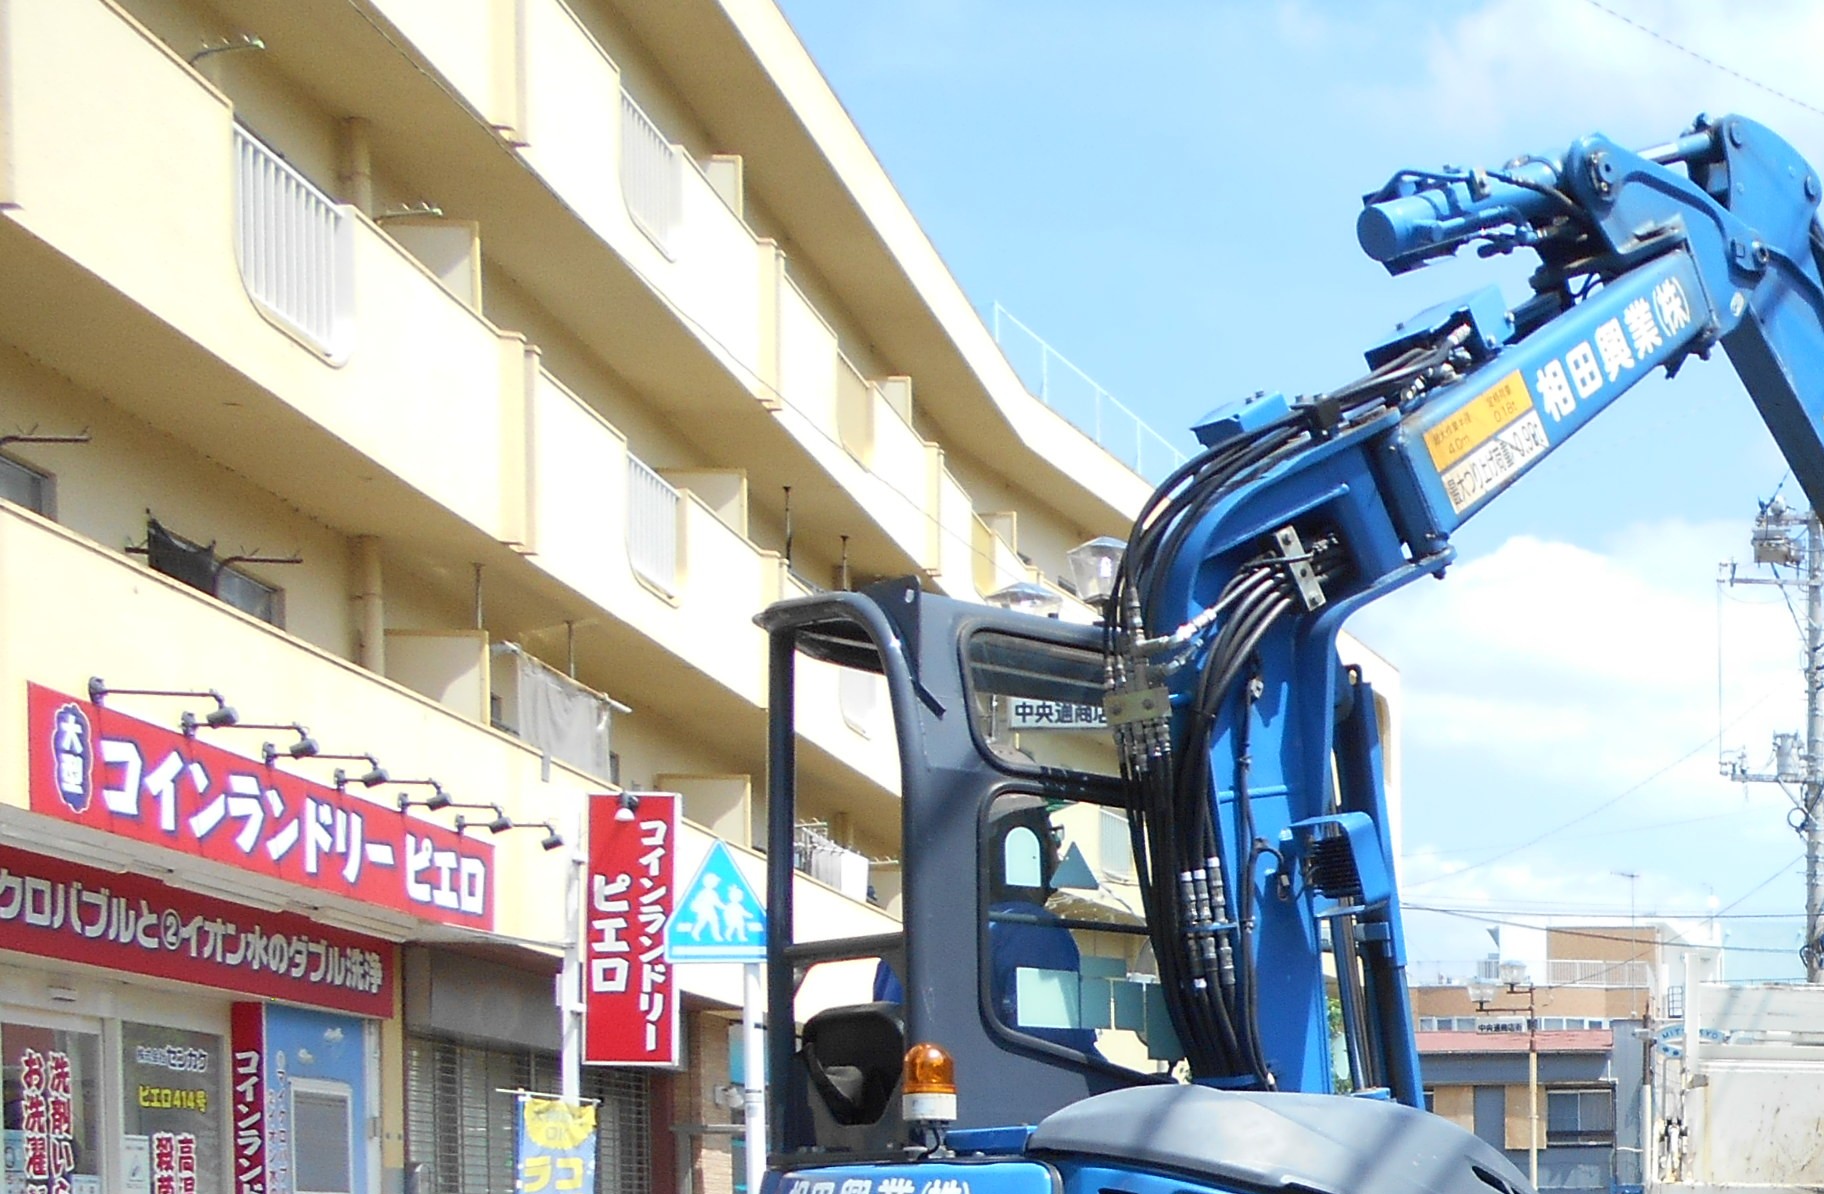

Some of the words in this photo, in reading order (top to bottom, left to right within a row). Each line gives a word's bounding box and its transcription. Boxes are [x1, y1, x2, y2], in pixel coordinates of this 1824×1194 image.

[1536, 276, 1691, 422] 相田興業(株)
[60, 716, 85, 795] 大型
[101, 738, 396, 885] コインランドリー
[405, 831, 487, 915] ピエロ
[591, 873, 632, 992] ピエロ
[638, 819, 668, 1052] コインランドリー
[21, 1048, 49, 1179] お洗濯
[138, 1085, 208, 1114] ピエロ414号
